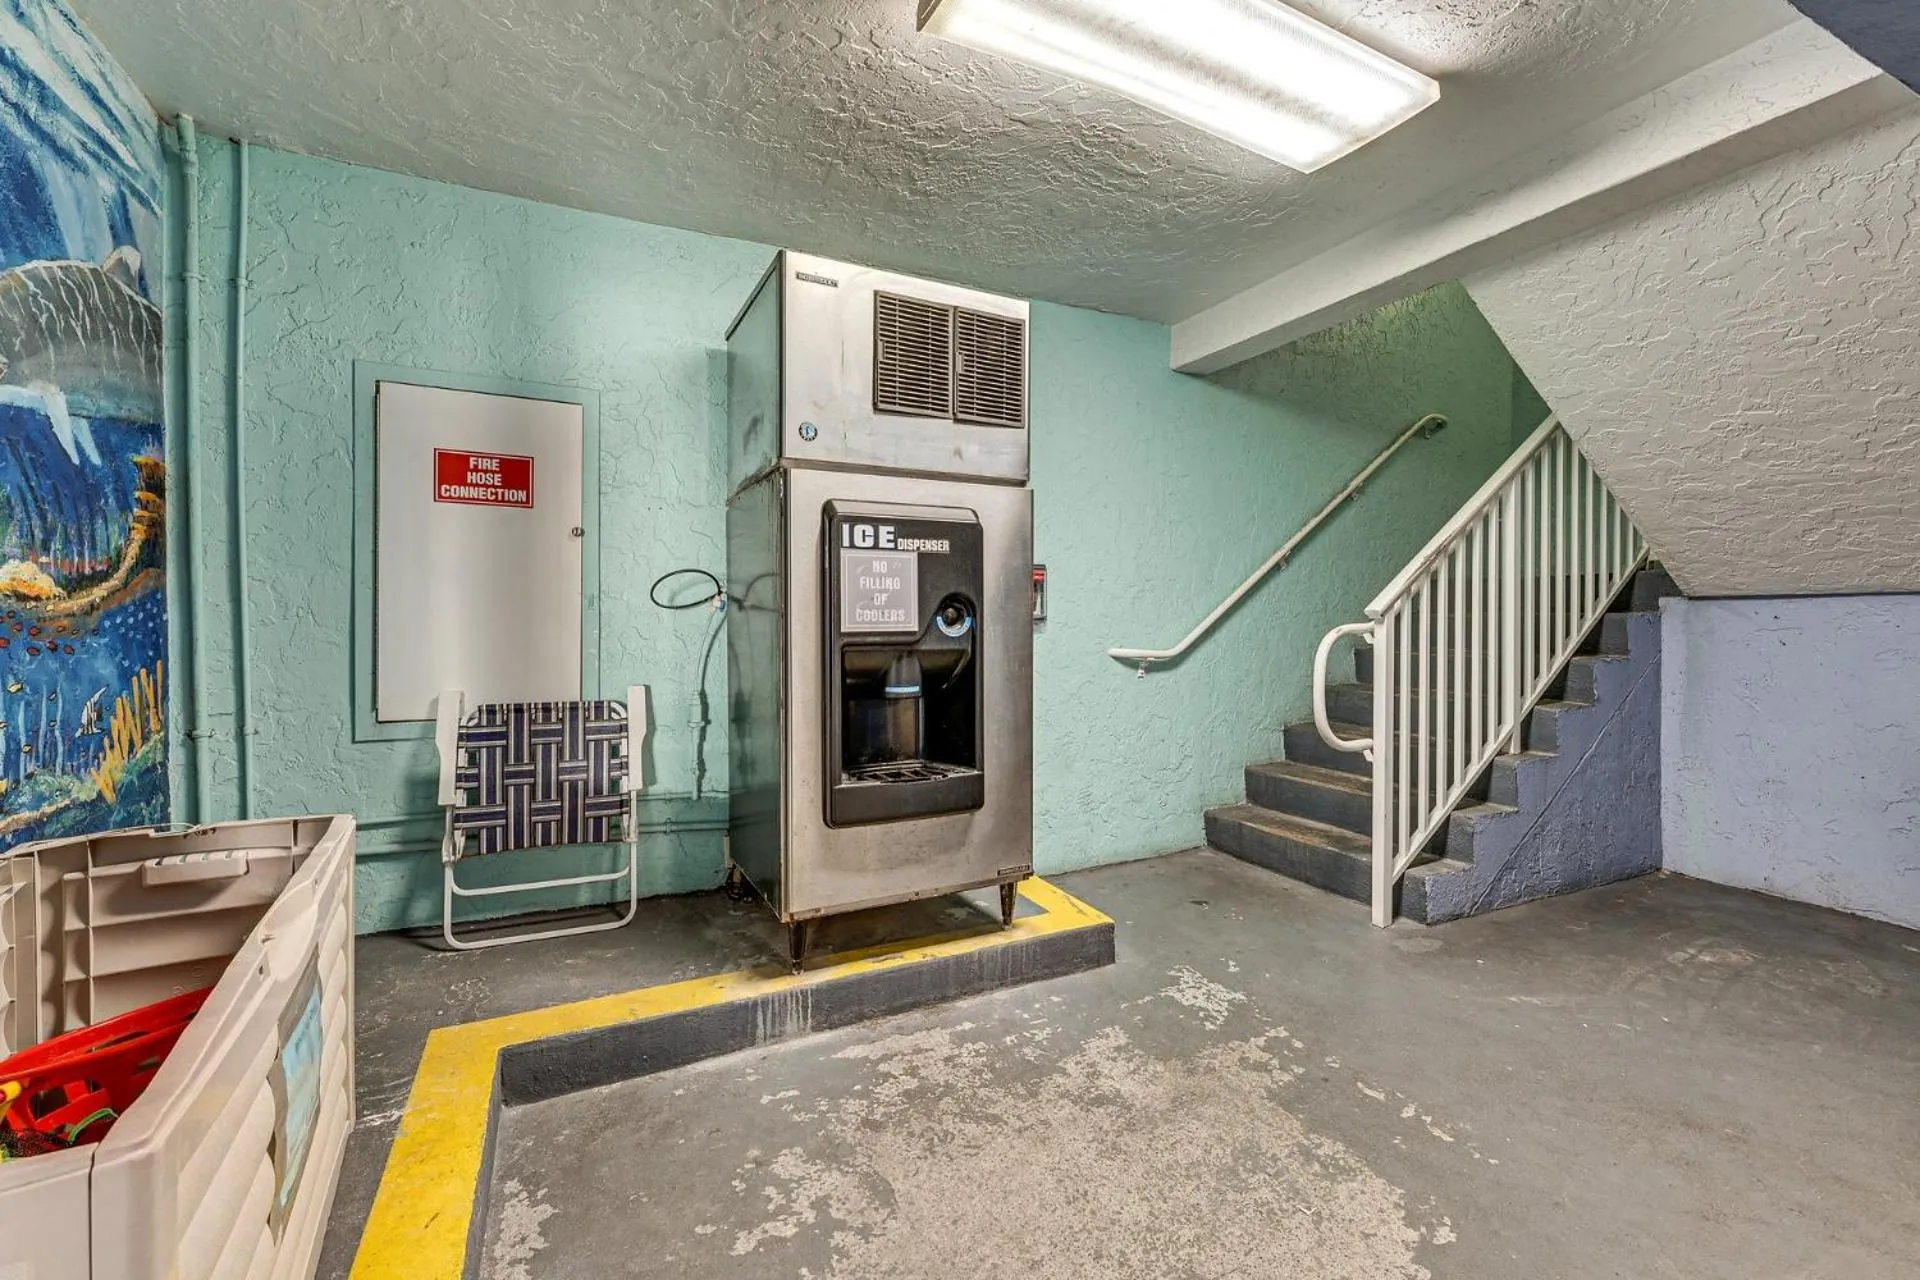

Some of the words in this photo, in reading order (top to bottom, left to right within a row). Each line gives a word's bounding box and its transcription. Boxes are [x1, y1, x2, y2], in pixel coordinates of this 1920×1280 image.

[469, 457, 500, 471] FIRE
[467, 471, 502, 486] HOSE
[441, 485, 526, 502] CONNECTION
[842, 524, 895, 548] ICE
[897, 539, 949, 551] DISPENSER
[872, 560, 887, 573] NO
[860, 576, 900, 590] FILLING
[874, 593, 888, 606] OF
[856, 608, 905, 622] COOLERS
